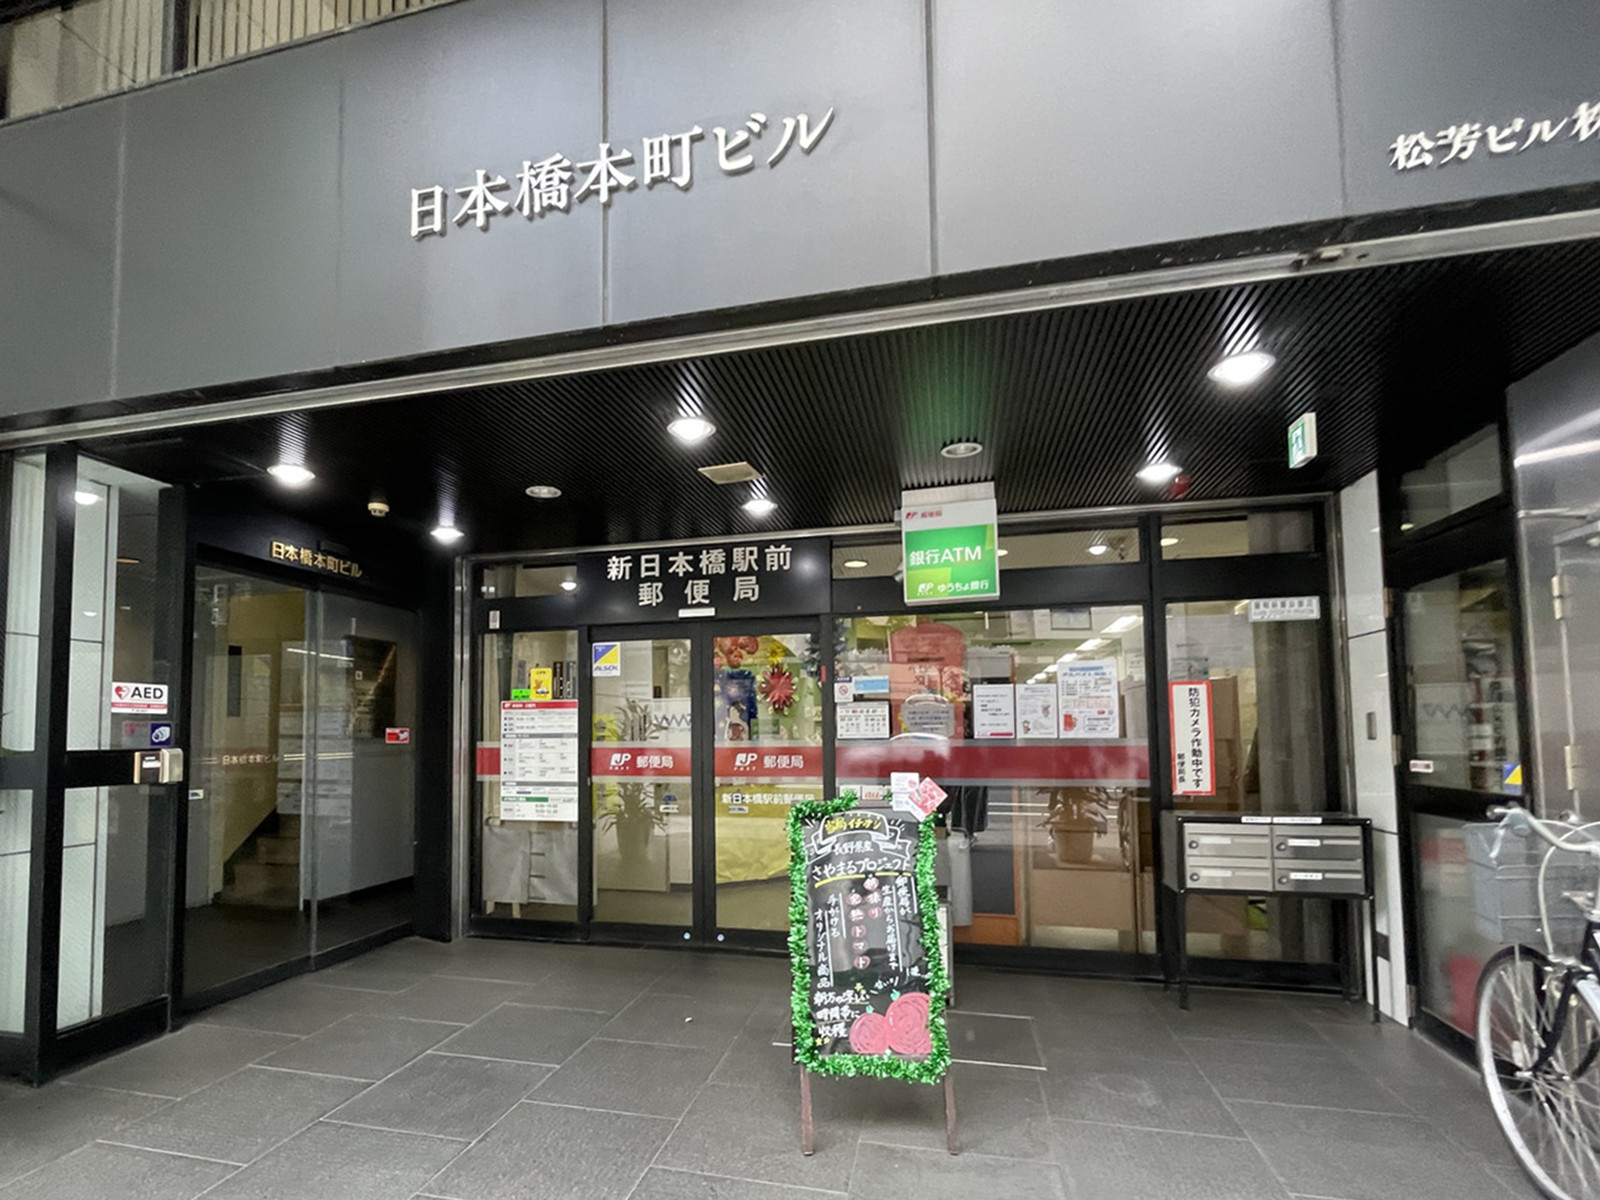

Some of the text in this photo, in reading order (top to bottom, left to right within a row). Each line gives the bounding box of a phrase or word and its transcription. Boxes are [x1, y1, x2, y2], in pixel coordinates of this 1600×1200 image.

[409, 106, 835, 238] 日本橋本町ビル
[272, 541, 363, 578] 日本橋本町ビル
[607, 544, 792, 581] 新日本橋駅前
[909, 545, 982, 567] 銀行ATM
[638, 576, 760, 607] 郵便局
[131, 686, 164, 700] AED
[1188, 687, 1203, 789] 防犯カメラ作動中です
[636, 755, 674, 769] 郵便局
[763, 754, 805, 769] 郵便局
[812, 857, 911, 878] さやまるプロジェクト
